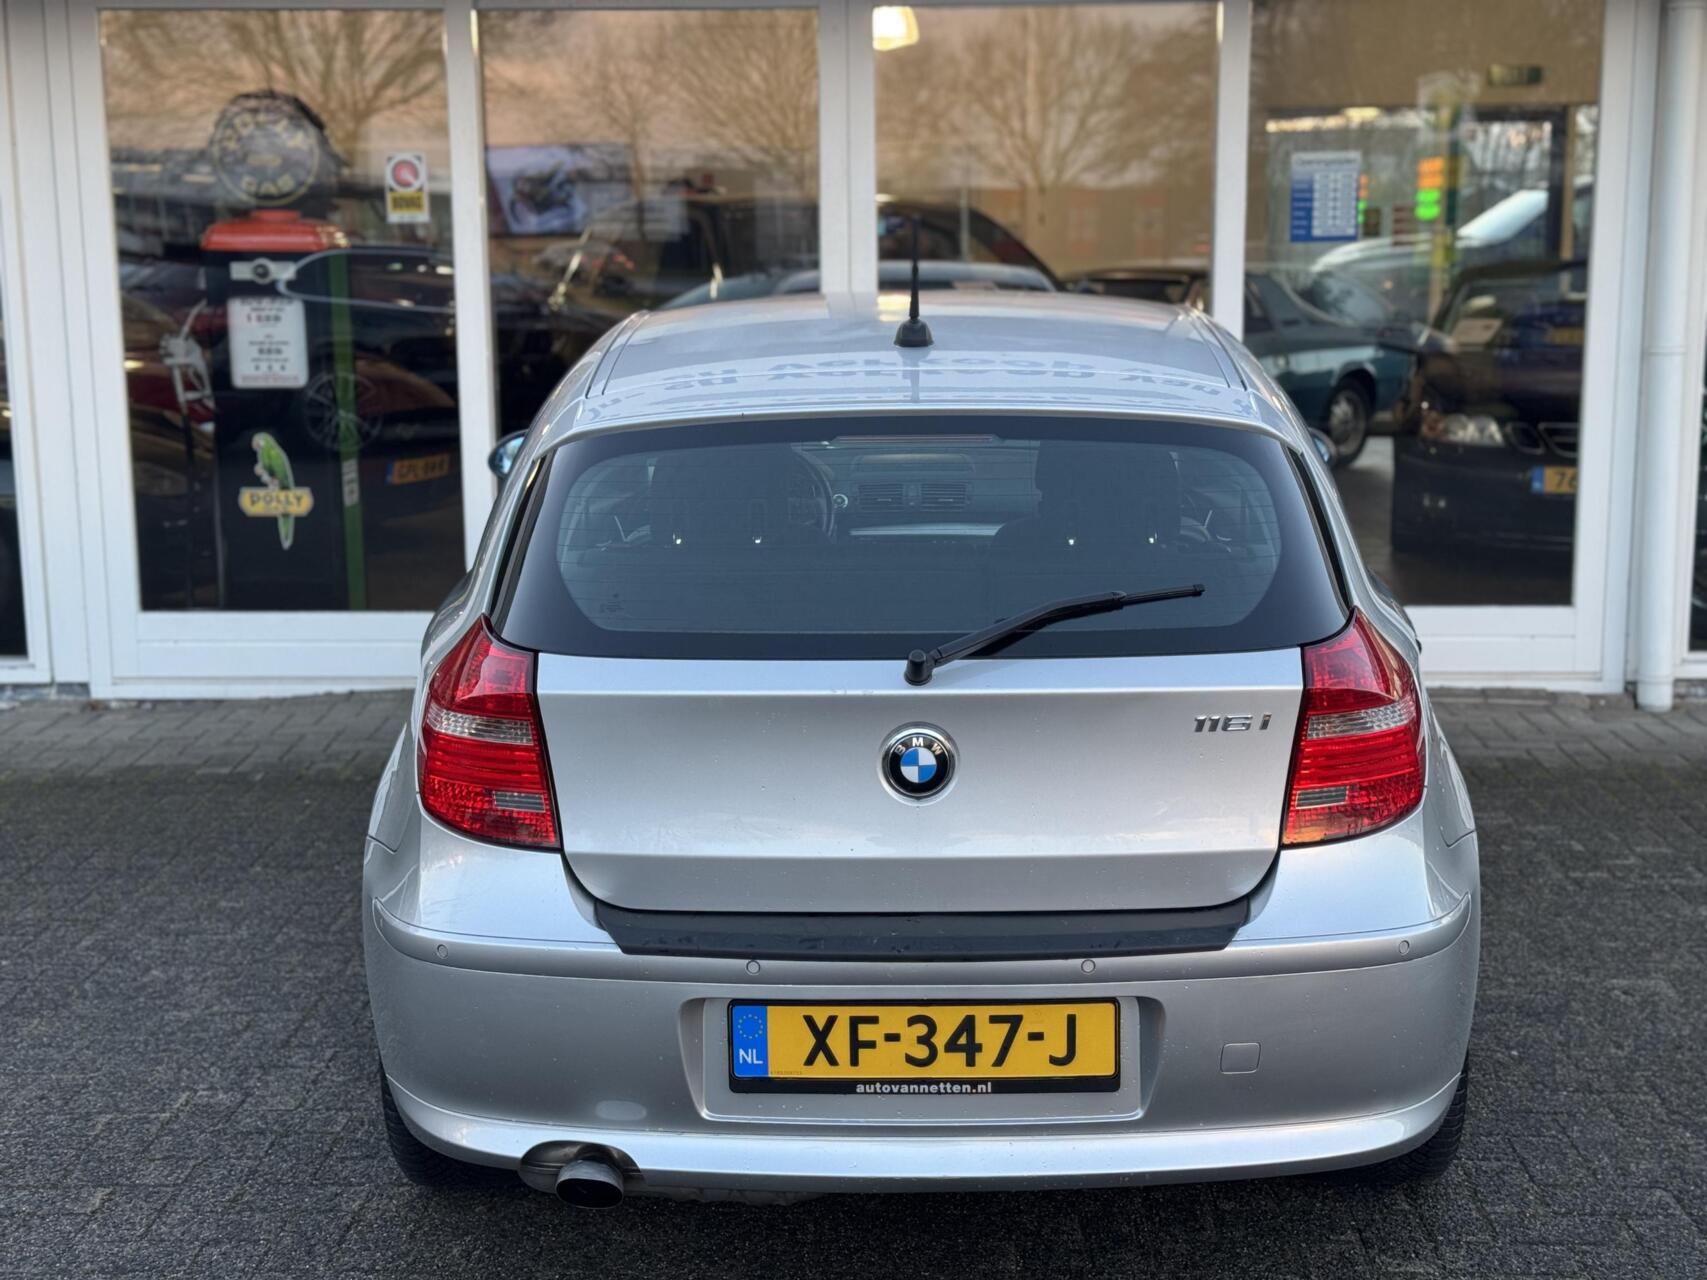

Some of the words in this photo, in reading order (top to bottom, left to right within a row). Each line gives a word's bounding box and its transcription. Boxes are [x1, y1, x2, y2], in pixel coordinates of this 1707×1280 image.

[248, 490, 305, 508] POLLY
[894, 736, 944, 756] BMW
[802, 1013, 1077, 1068] XF-347-J
[739, 1048, 764, 1064] NL
[856, 1082, 992, 1094] autovannetten.nl
